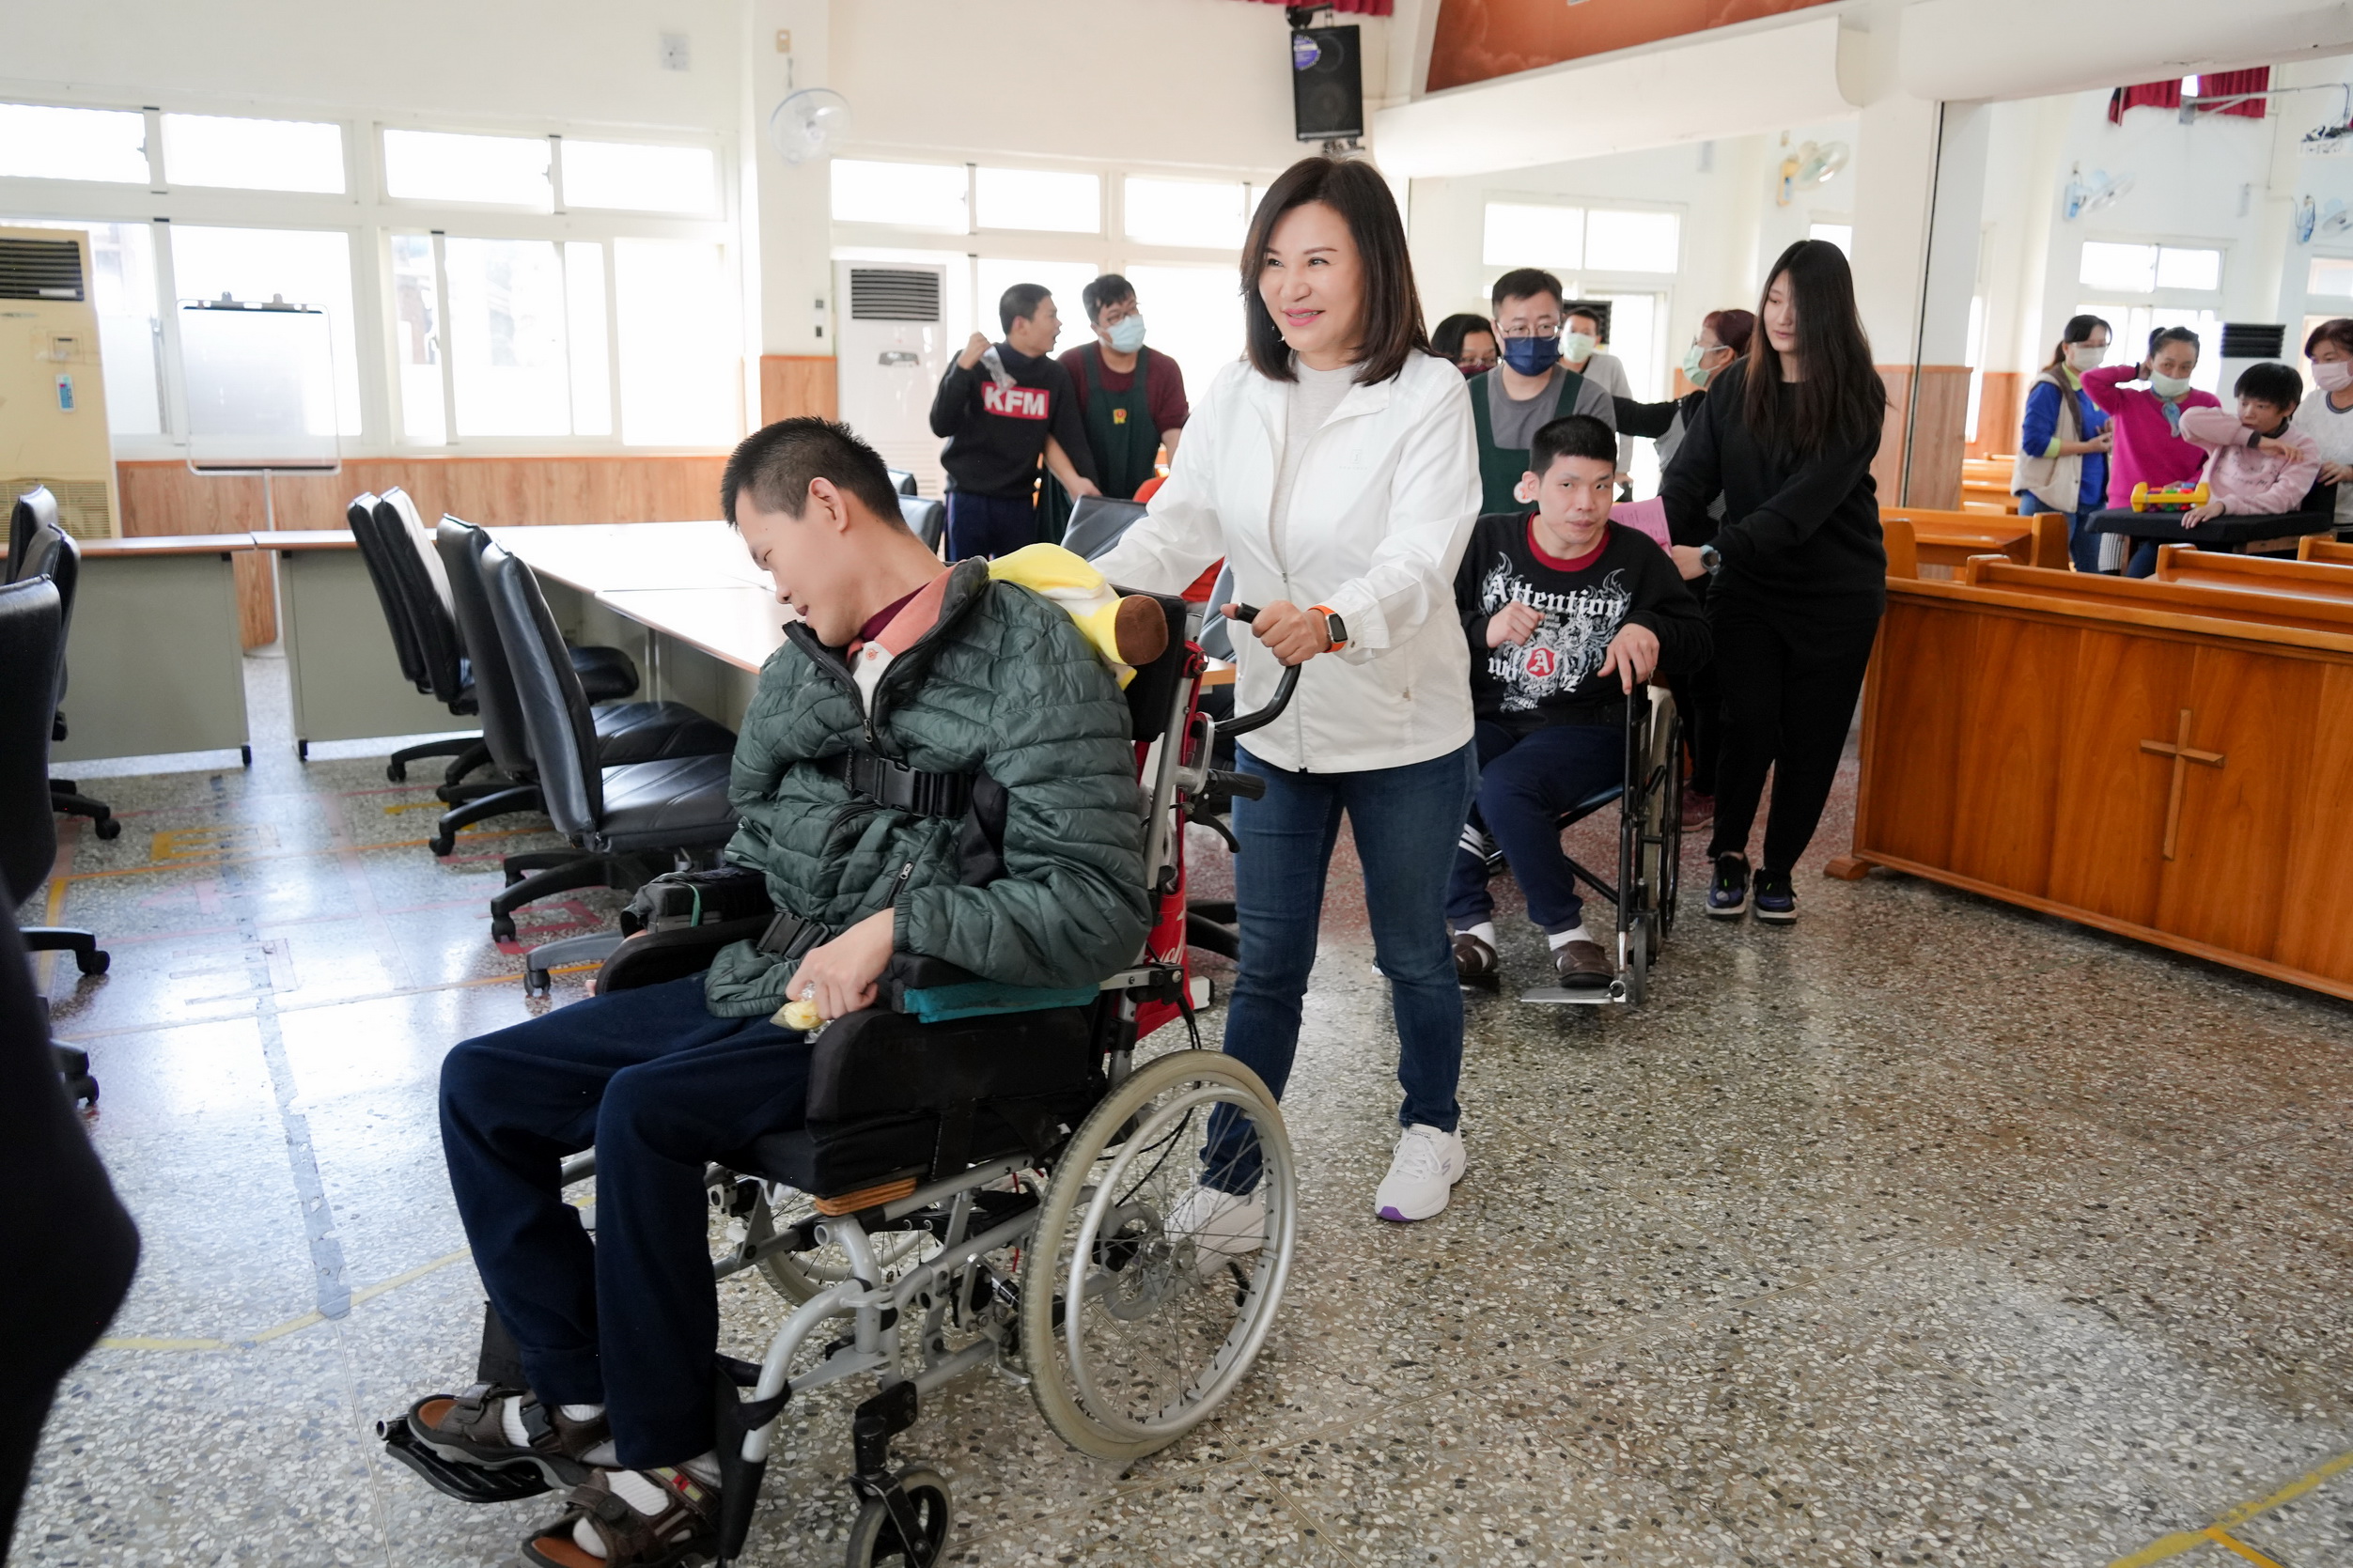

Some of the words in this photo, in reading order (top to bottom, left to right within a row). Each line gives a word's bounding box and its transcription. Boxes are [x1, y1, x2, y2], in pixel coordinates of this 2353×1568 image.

[985, 386, 1045, 416] KFM
[1484, 574, 1623, 617] Attention
[1529, 649, 1551, 674] A
